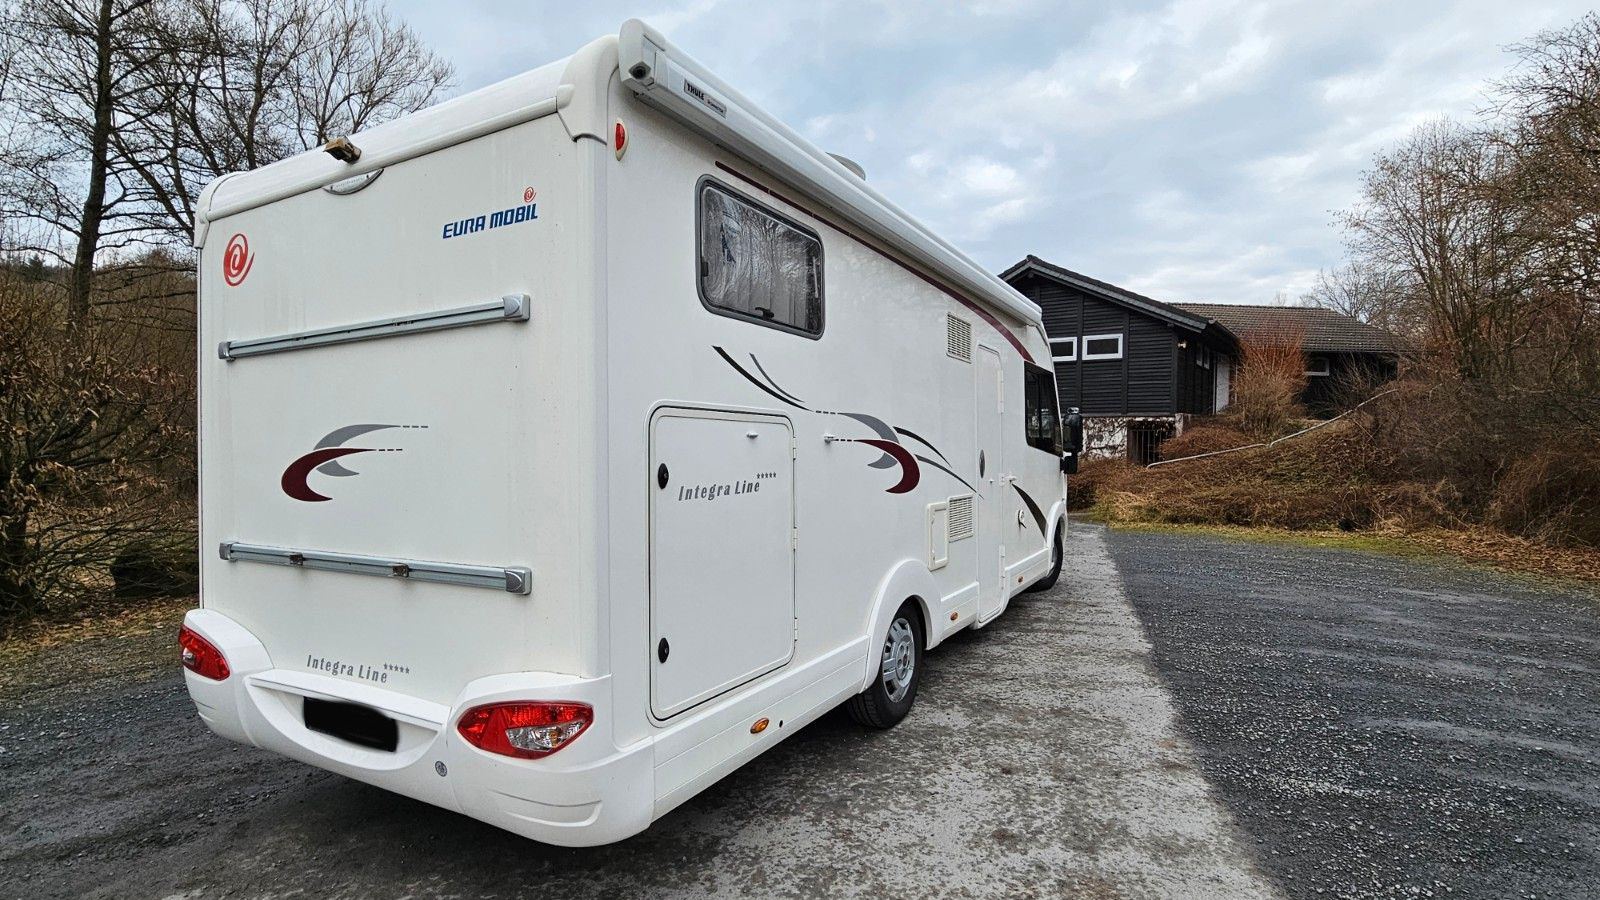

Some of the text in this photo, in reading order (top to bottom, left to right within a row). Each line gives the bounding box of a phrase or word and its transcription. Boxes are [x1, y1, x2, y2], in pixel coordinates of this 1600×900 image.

[687, 82, 705, 101] THULE
[442, 203, 538, 239] EURA MOBIL
[678, 480, 760, 501] Integra Line
[306, 654, 388, 683] Integra Line
